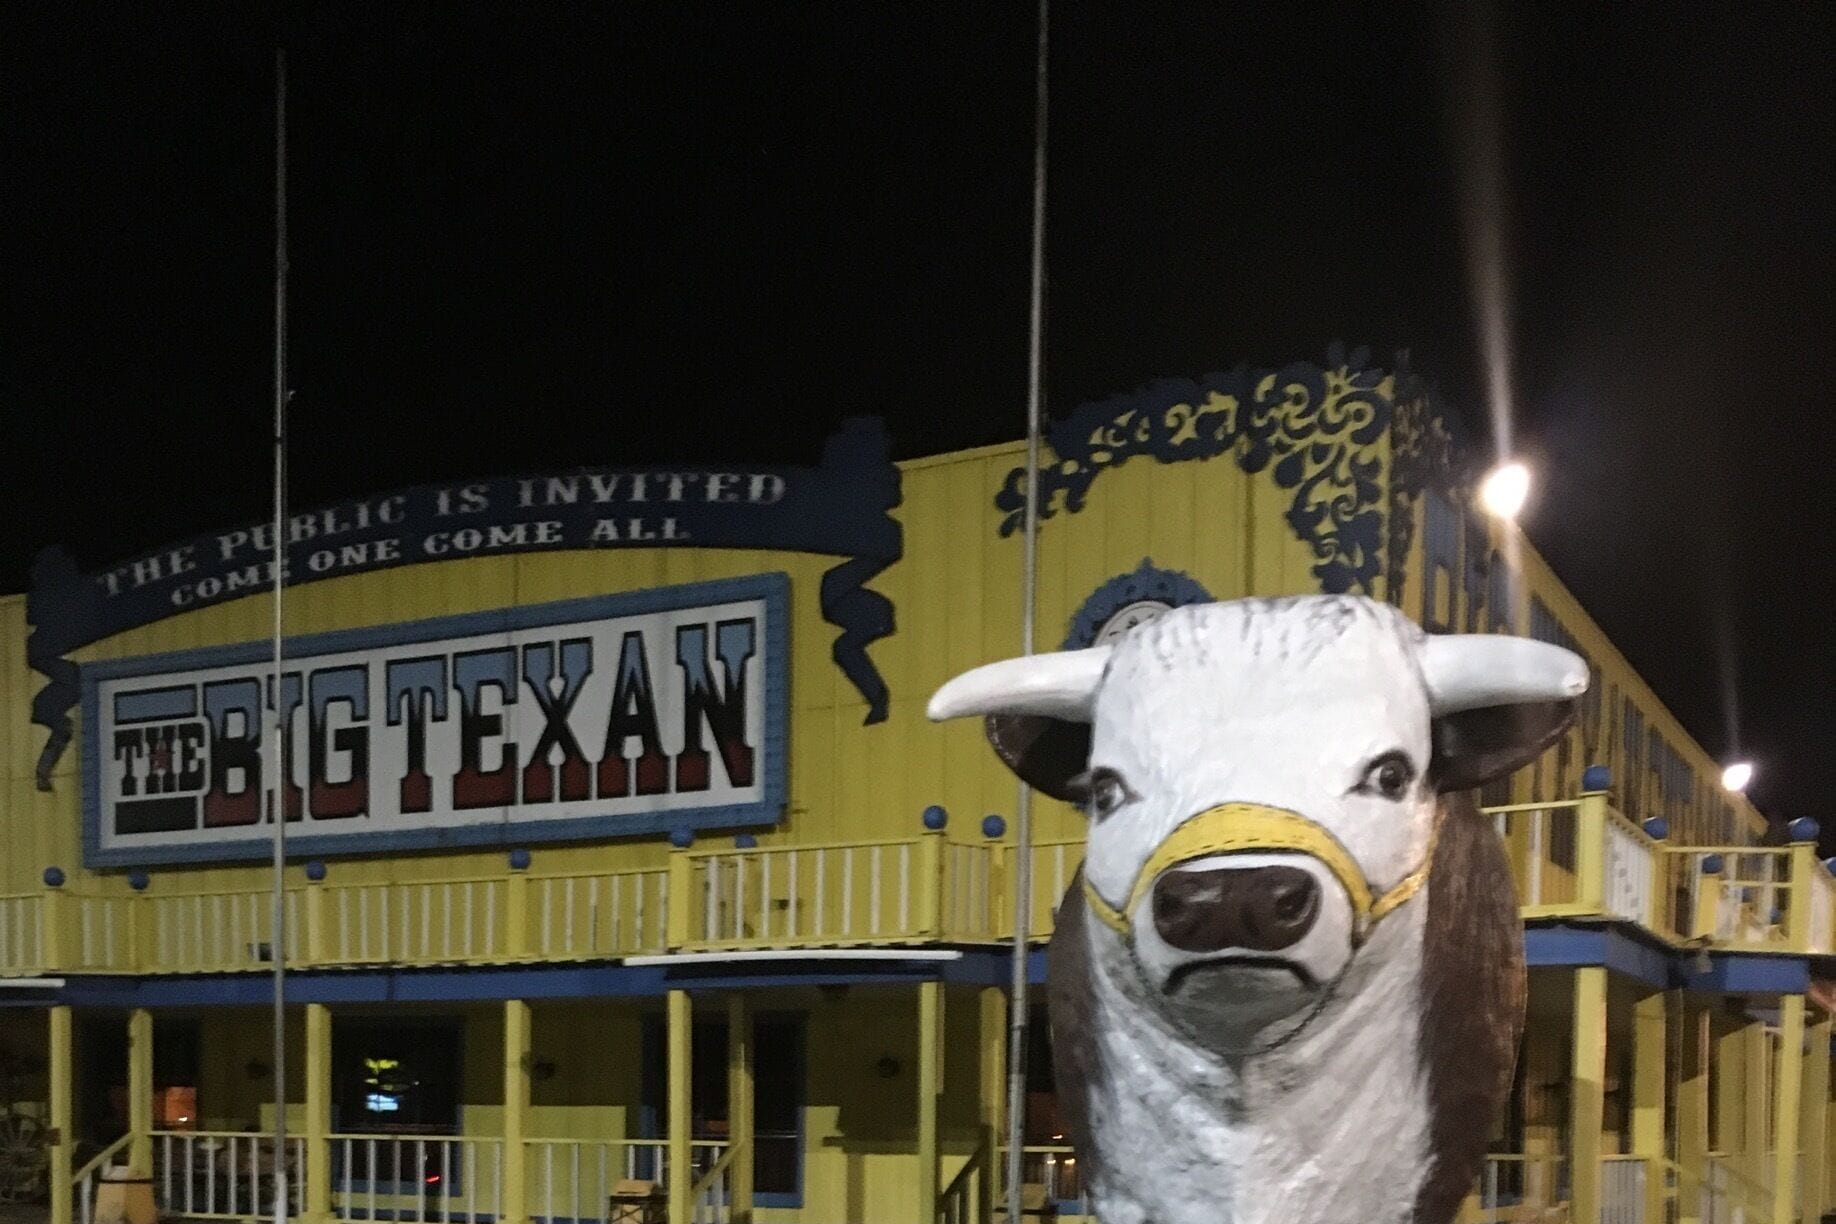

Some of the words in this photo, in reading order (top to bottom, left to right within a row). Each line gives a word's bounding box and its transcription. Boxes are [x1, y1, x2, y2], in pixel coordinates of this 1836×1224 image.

[99, 546, 197, 597] THE
[216, 495, 406, 561] PUBLIC
[436, 483, 490, 517] IS
[517, 472, 787, 508] INVITED
[170, 555, 291, 606] COME
[308, 538, 401, 572] ONE
[423, 520, 565, 556] COME
[589, 517, 693, 543] ALL
[114, 722, 206, 797] THE
[203, 663, 370, 830] BIG
[386, 616, 755, 815] TEXAN
